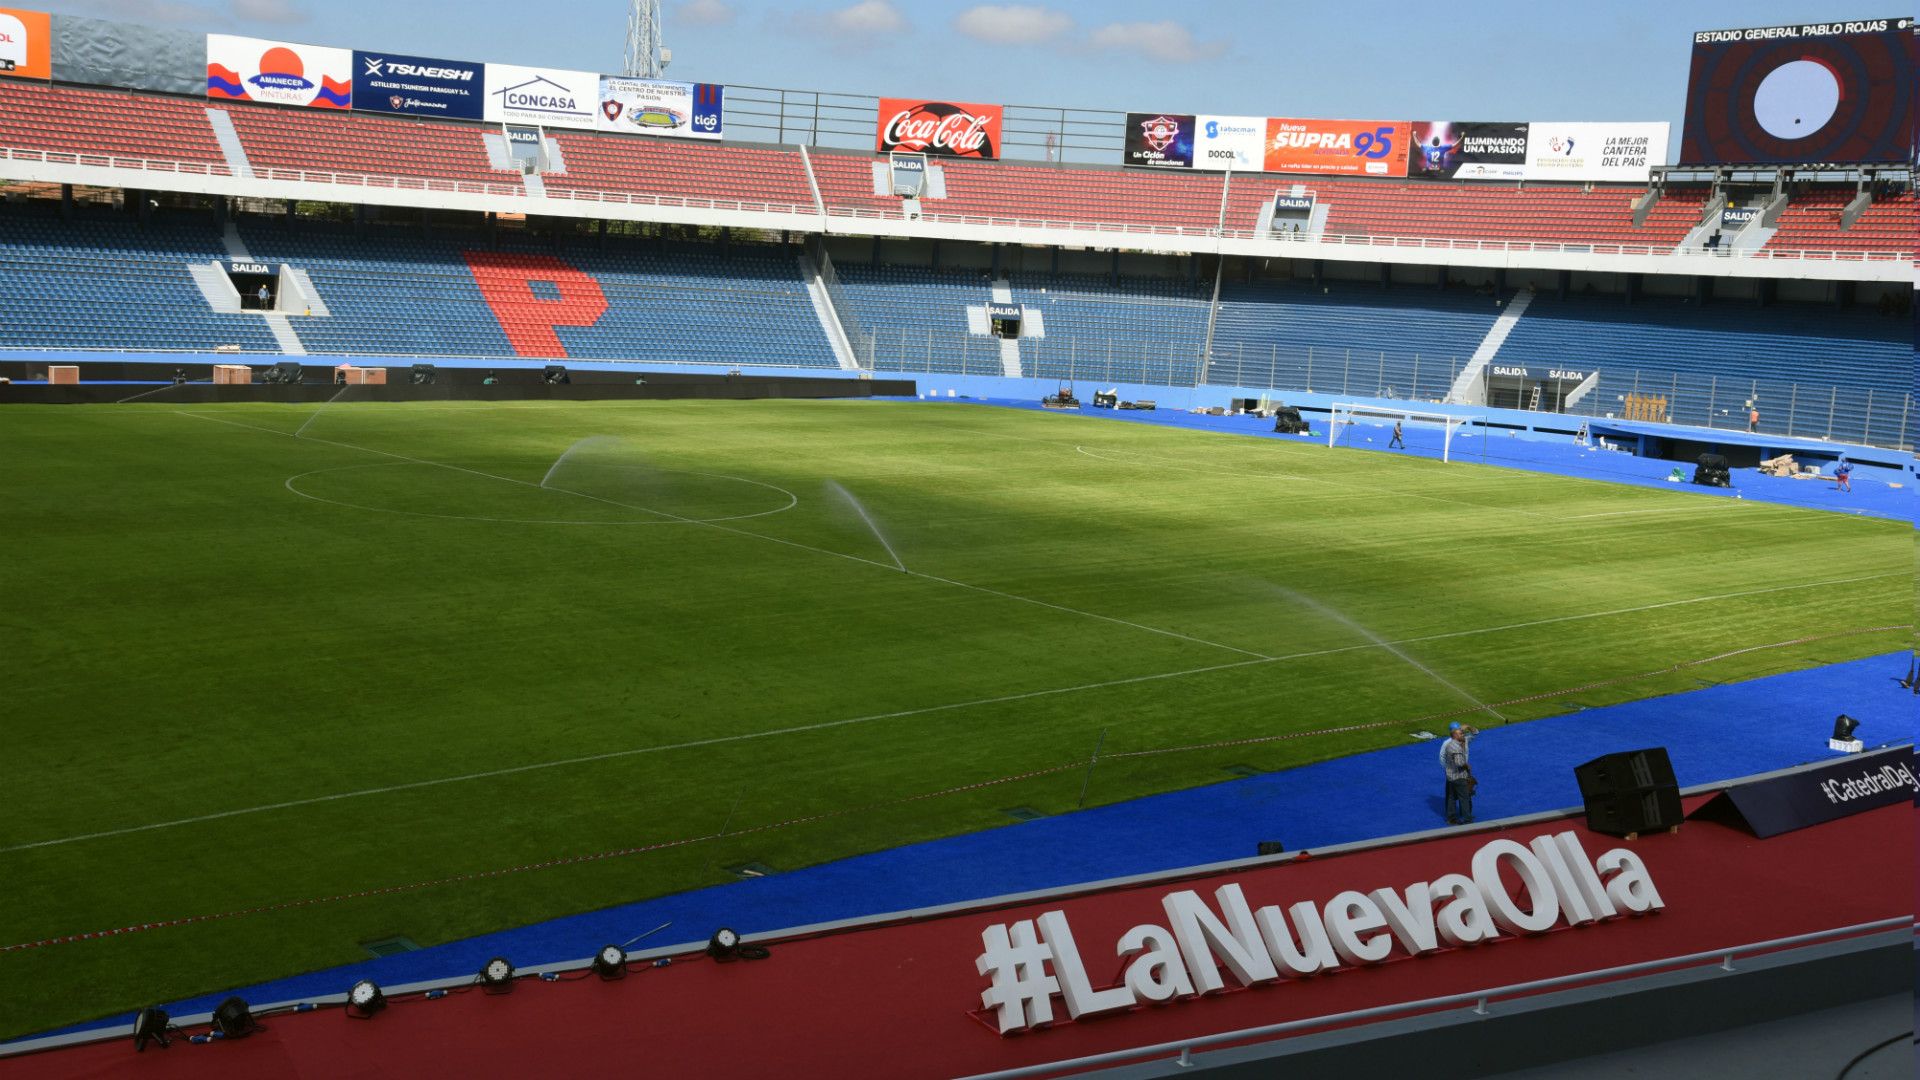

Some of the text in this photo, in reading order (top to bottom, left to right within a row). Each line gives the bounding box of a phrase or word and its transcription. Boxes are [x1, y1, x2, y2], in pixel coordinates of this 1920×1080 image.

[1695, 20, 1887, 43] ESTADIO GENERAL PABLO ROJAS
[385, 63, 475, 81] TSUNEISHI
[259, 76, 304, 88] AMANECER
[370, 81, 401, 89] ASTILLERO
[401, 84, 429, 92] TSUNEISHI
[429, 86, 459, 95] PARAGUAY
[618, 86, 645, 94] CENTRO
[656, 89, 687, 97] NUESTRA
[260, 90, 303, 101] PINTURAS
[508, 93, 577, 109] CONCASA
[1279, 123, 1307, 132] Nueva
[508, 131, 538, 142] SALIDA
[1464, 137, 1525, 146] ILUMINANDO
[1605, 137, 1649, 145] LA MEJOR
[1273, 127, 1395, 159] SUPRA 95
[1463, 145, 1486, 153] UNA
[1602, 146, 1648, 155] CANTERA
[1208, 150, 1236, 159] DOCOL
[1431, 151, 1441, 162] 12
[893, 160, 922, 170] SALIDA
[1601, 157, 1620, 167] DEL
[1279, 199, 1311, 208] SALIDA
[232, 263, 269, 273] SALIDA
[989, 306, 1020, 316] SALIDA
[1493, 366, 1528, 377] SALIDA
[1549, 370, 1583, 380] SALIDA
[975, 830, 1667, 1036] #LaNuevaOlla
